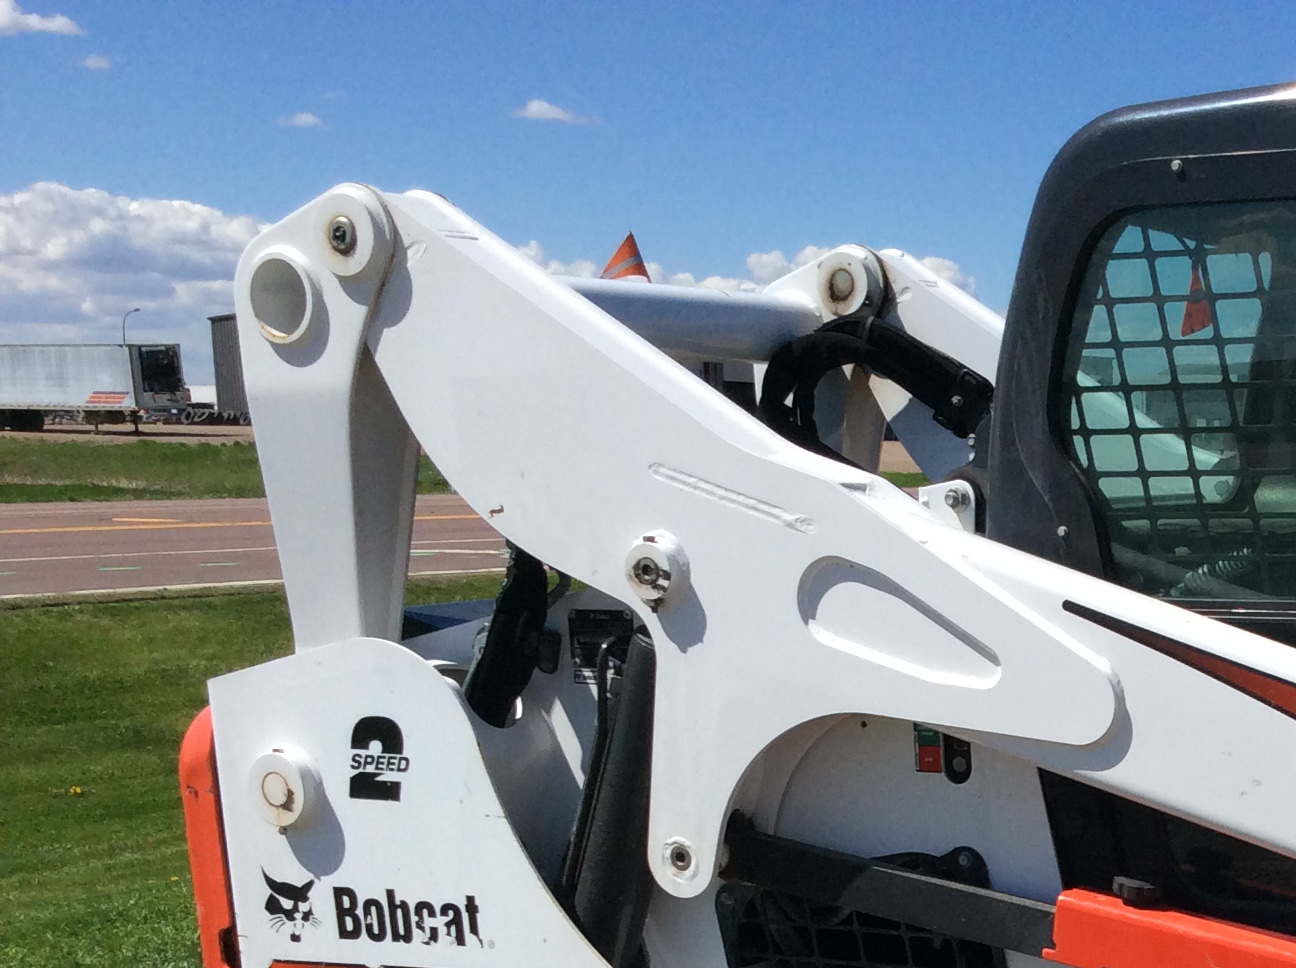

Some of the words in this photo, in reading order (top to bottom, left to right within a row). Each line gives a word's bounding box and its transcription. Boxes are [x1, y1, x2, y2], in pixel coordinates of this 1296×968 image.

[350, 716, 404, 802] 2
[350, 753, 409, 773] SPEED
[333, 886, 484, 948] Bobcat
